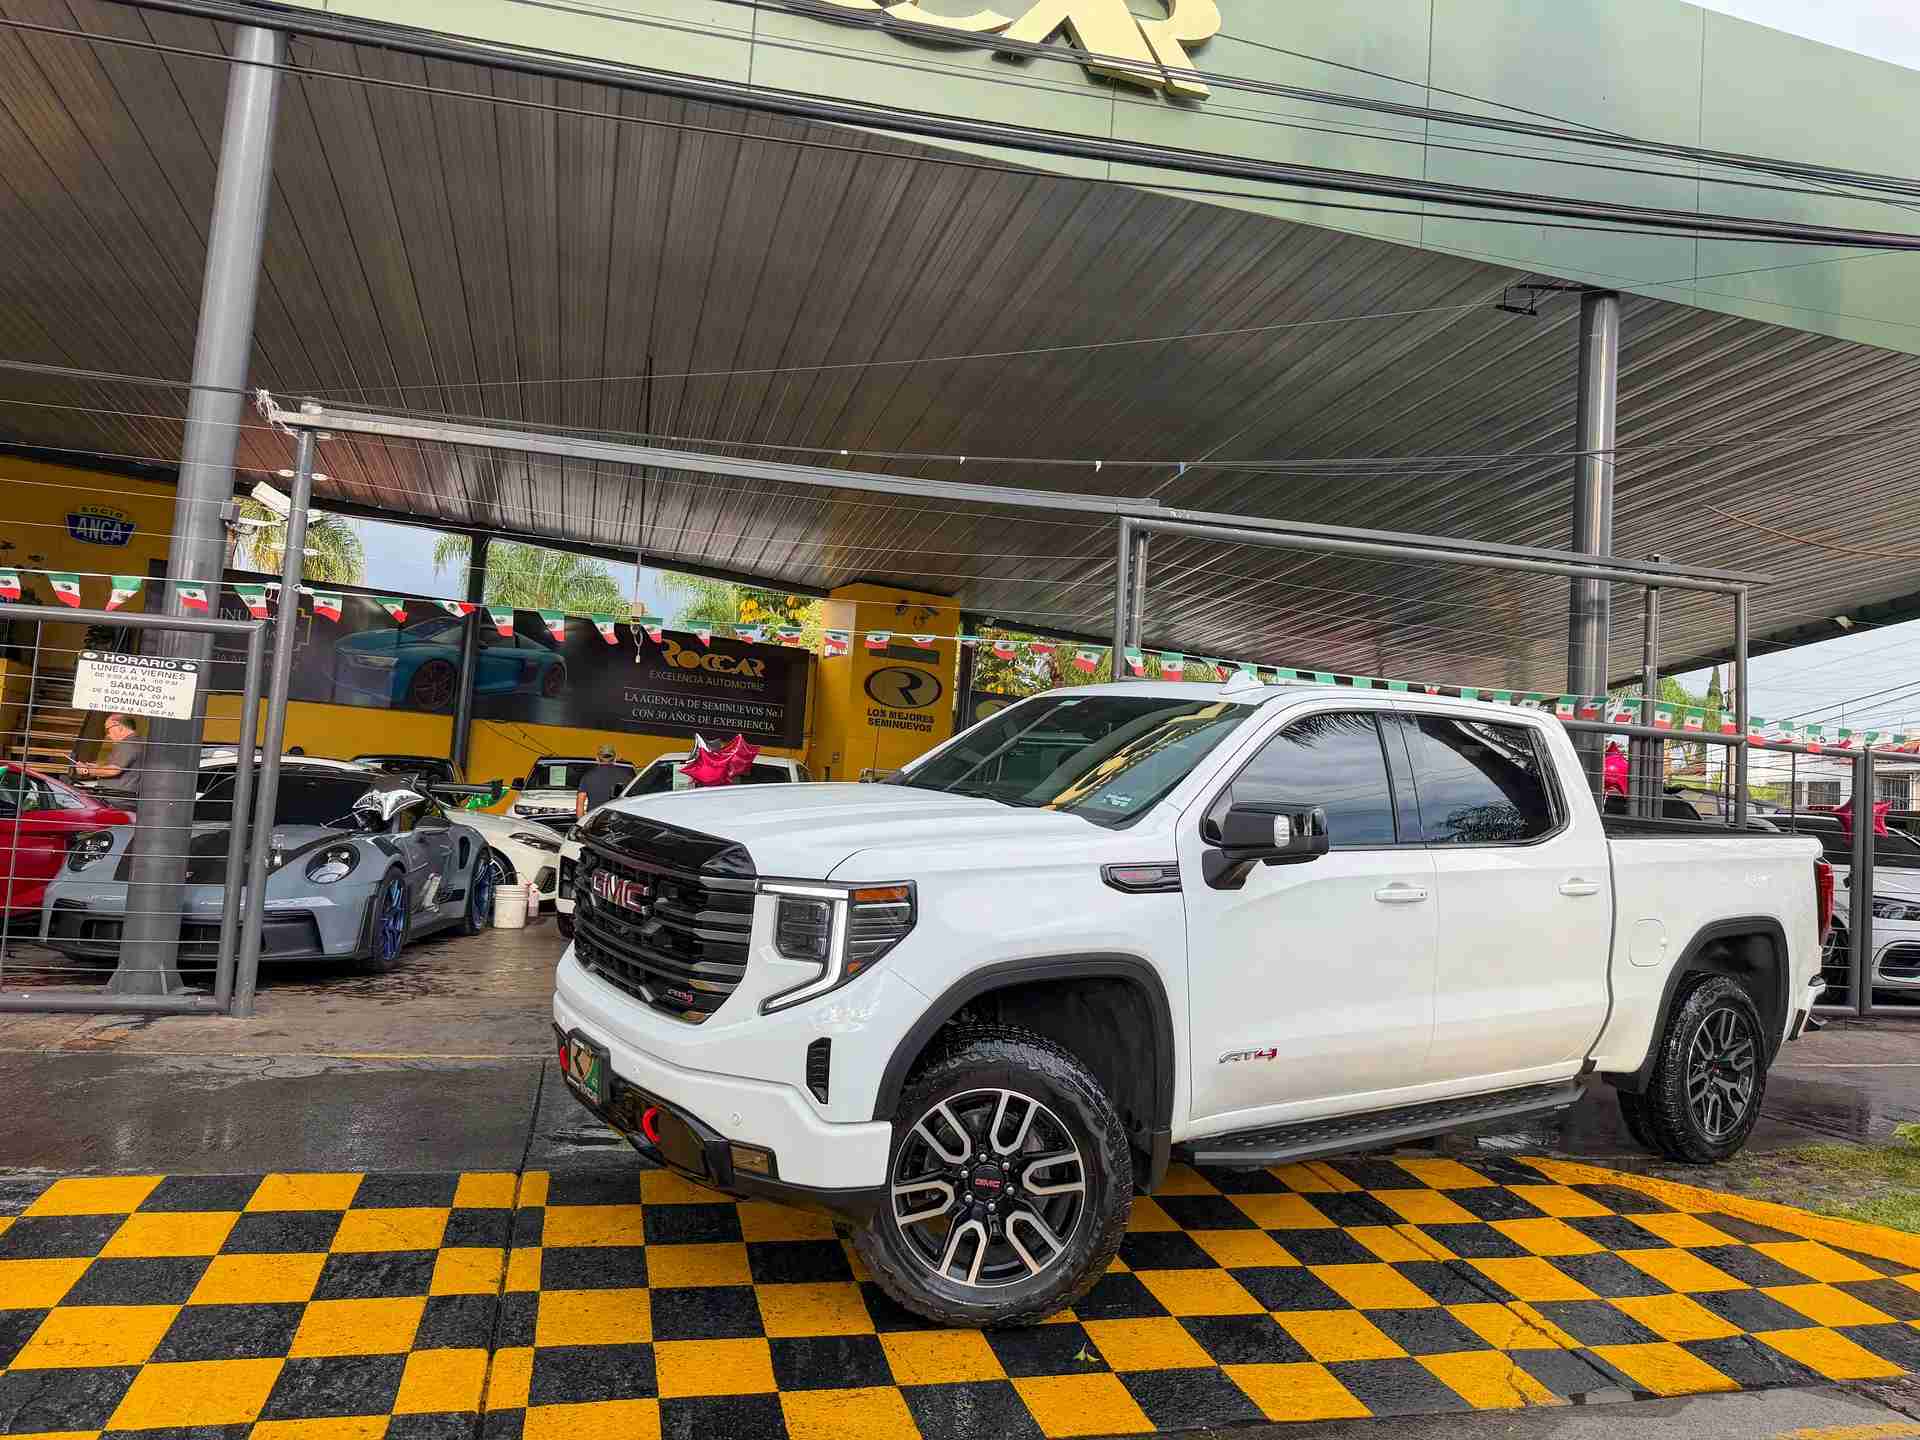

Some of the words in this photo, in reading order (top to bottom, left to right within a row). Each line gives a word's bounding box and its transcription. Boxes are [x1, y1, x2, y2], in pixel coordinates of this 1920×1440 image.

[102, 653, 177, 669] HORARIO
[89, 662, 127, 673] LUNES
[128, 666, 138, 674] A
[139, 668, 186, 680] VIERNES
[102, 694, 165, 709] DOMINGOS
[624, 691, 639, 703] LA
[640, 694, 684, 708] AGENCIA
[687, 697, 701, 709] DE
[702, 701, 764, 717] SEMINUEVOS
[632, 708, 654, 718] CON
[656, 710, 668, 720] 30
[669, 710, 696, 723] AÑOS
[698, 714, 712, 725] DE
[713, 716, 776, 732] EXPERIENCIA
[866, 708, 887, 718] LOS
[888, 711, 935, 724] MEJORES
[867, 717, 932, 733] SEMINUEVOS
[592, 868, 650, 914] GMC
[975, 1178, 1001, 1192] GMC
